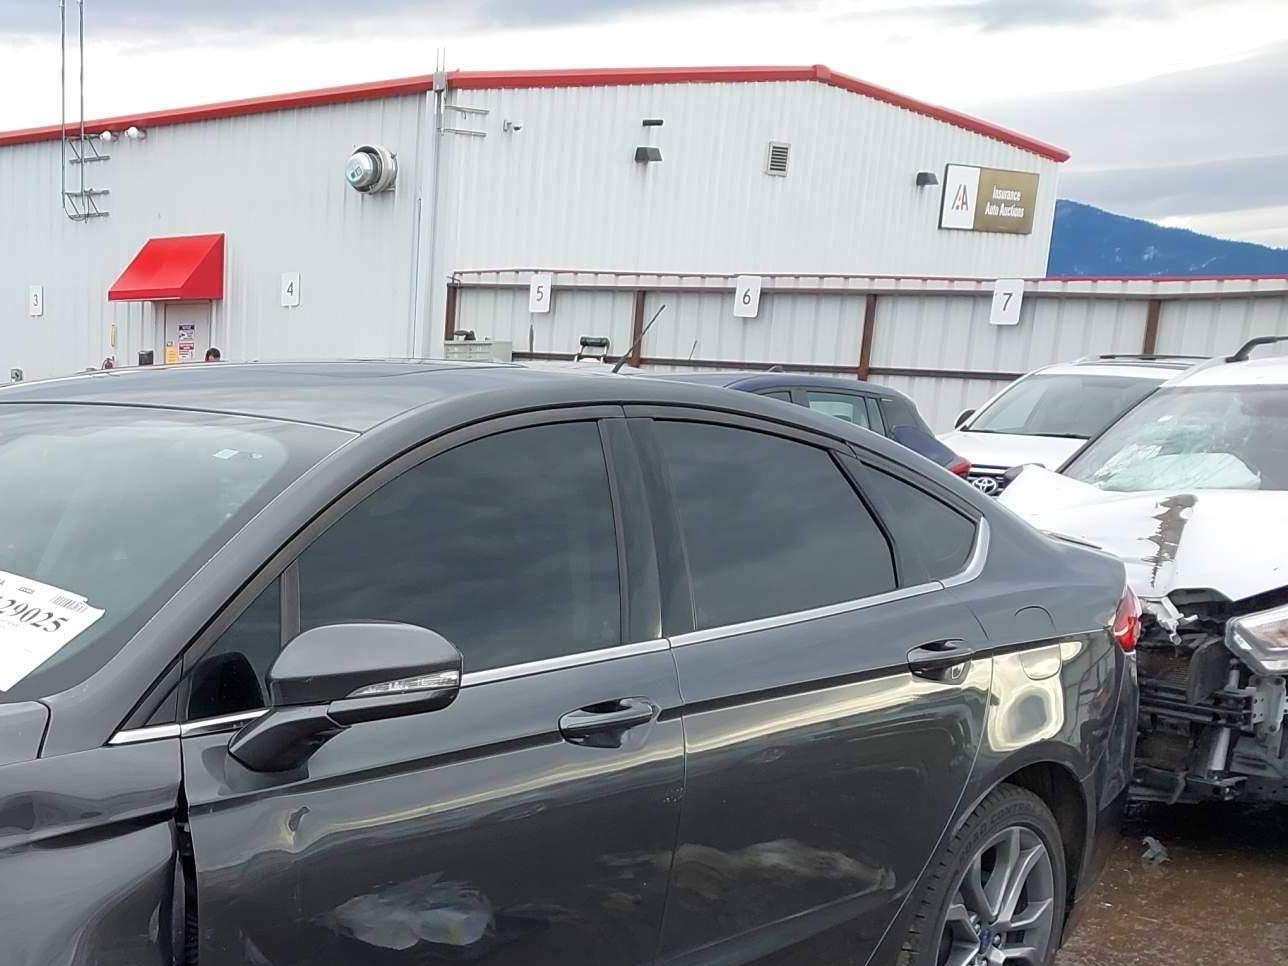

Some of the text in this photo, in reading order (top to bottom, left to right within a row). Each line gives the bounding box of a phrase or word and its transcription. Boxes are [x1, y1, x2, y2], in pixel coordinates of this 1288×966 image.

[992, 185, 1022, 201] Insurance
[984, 201, 1025, 218] Auto Auctions
[286, 281, 294, 297] 4
[536, 285, 544, 302] 5
[742, 287, 752, 305] 6
[32, 293, 39, 307] 3
[1002, 292, 1014, 312] 7
